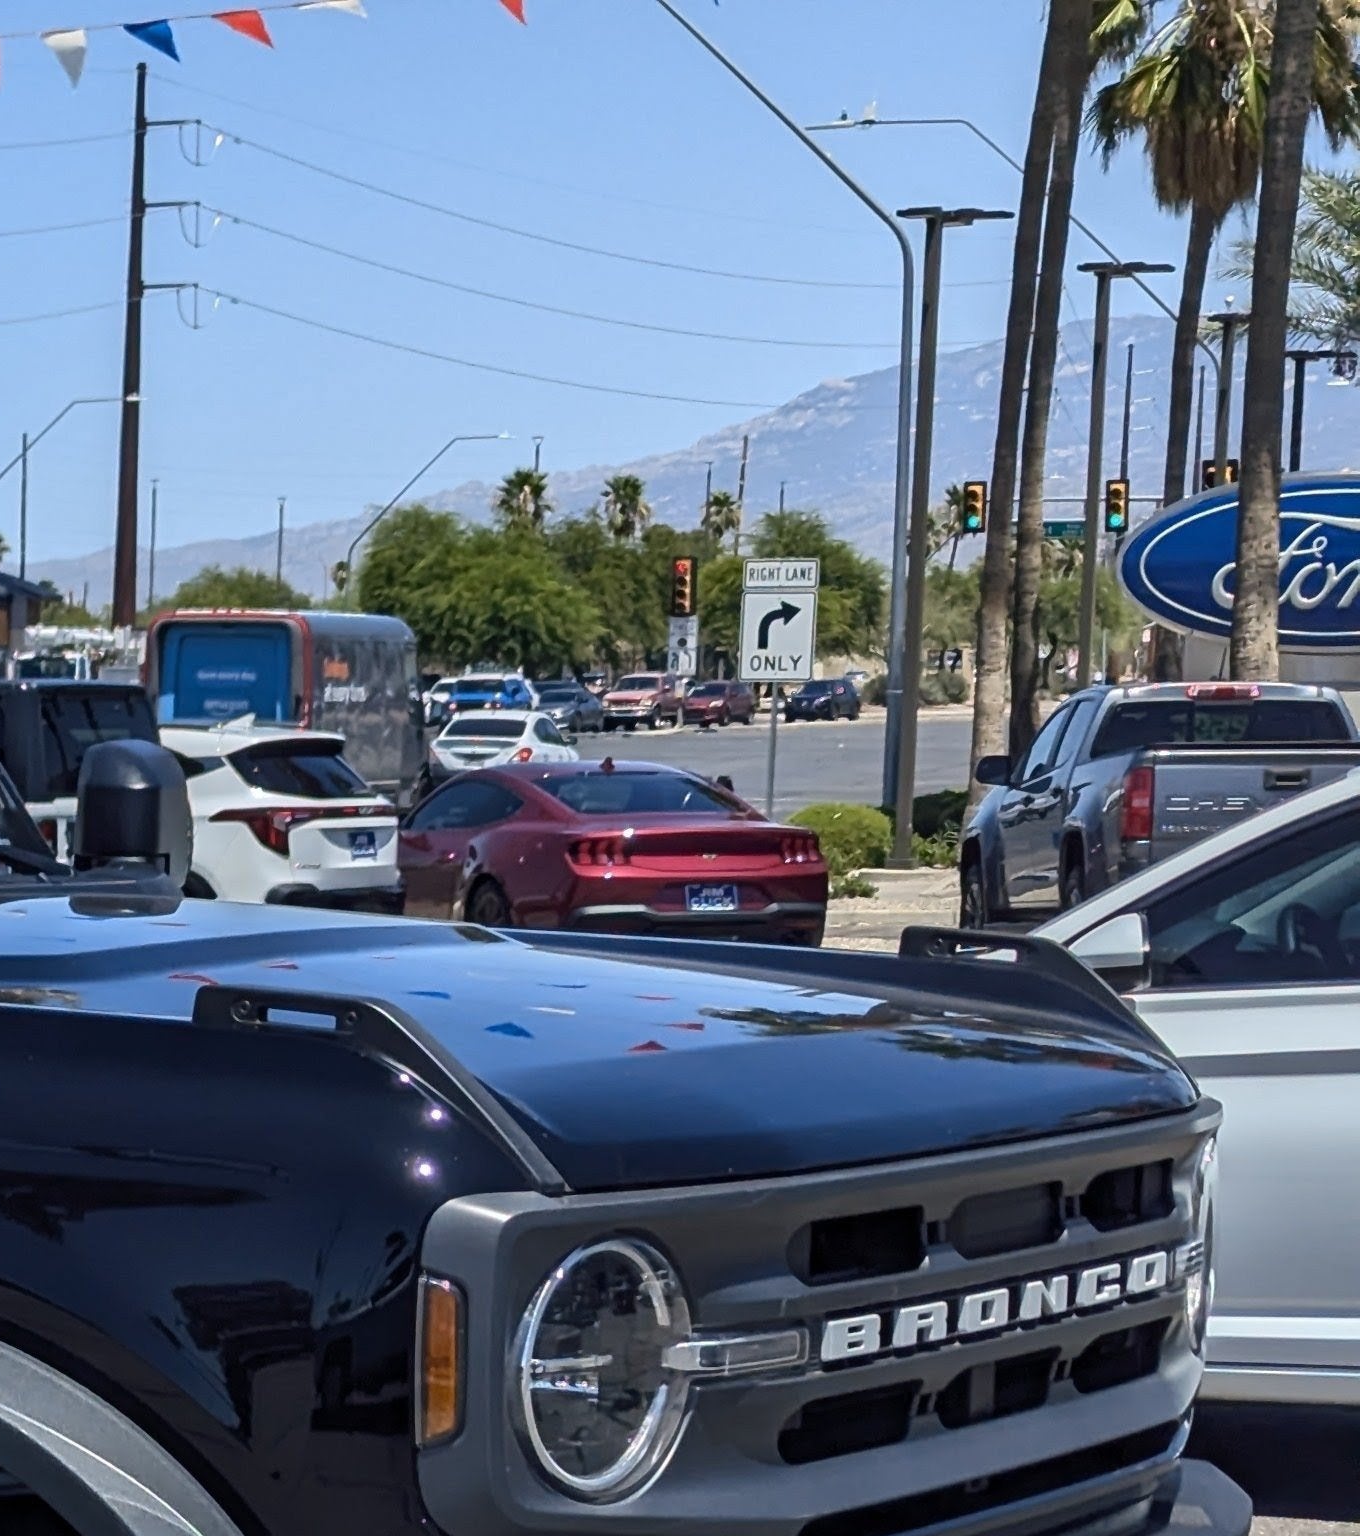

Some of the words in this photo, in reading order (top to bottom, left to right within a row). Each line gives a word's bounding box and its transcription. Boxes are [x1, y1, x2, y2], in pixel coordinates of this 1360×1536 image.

[748, 567, 781, 581] RIGHT
[785, 566, 814, 581] LANE
[749, 655, 802, 671] ONLY
[820, 1250, 1169, 1363] BRONCO
